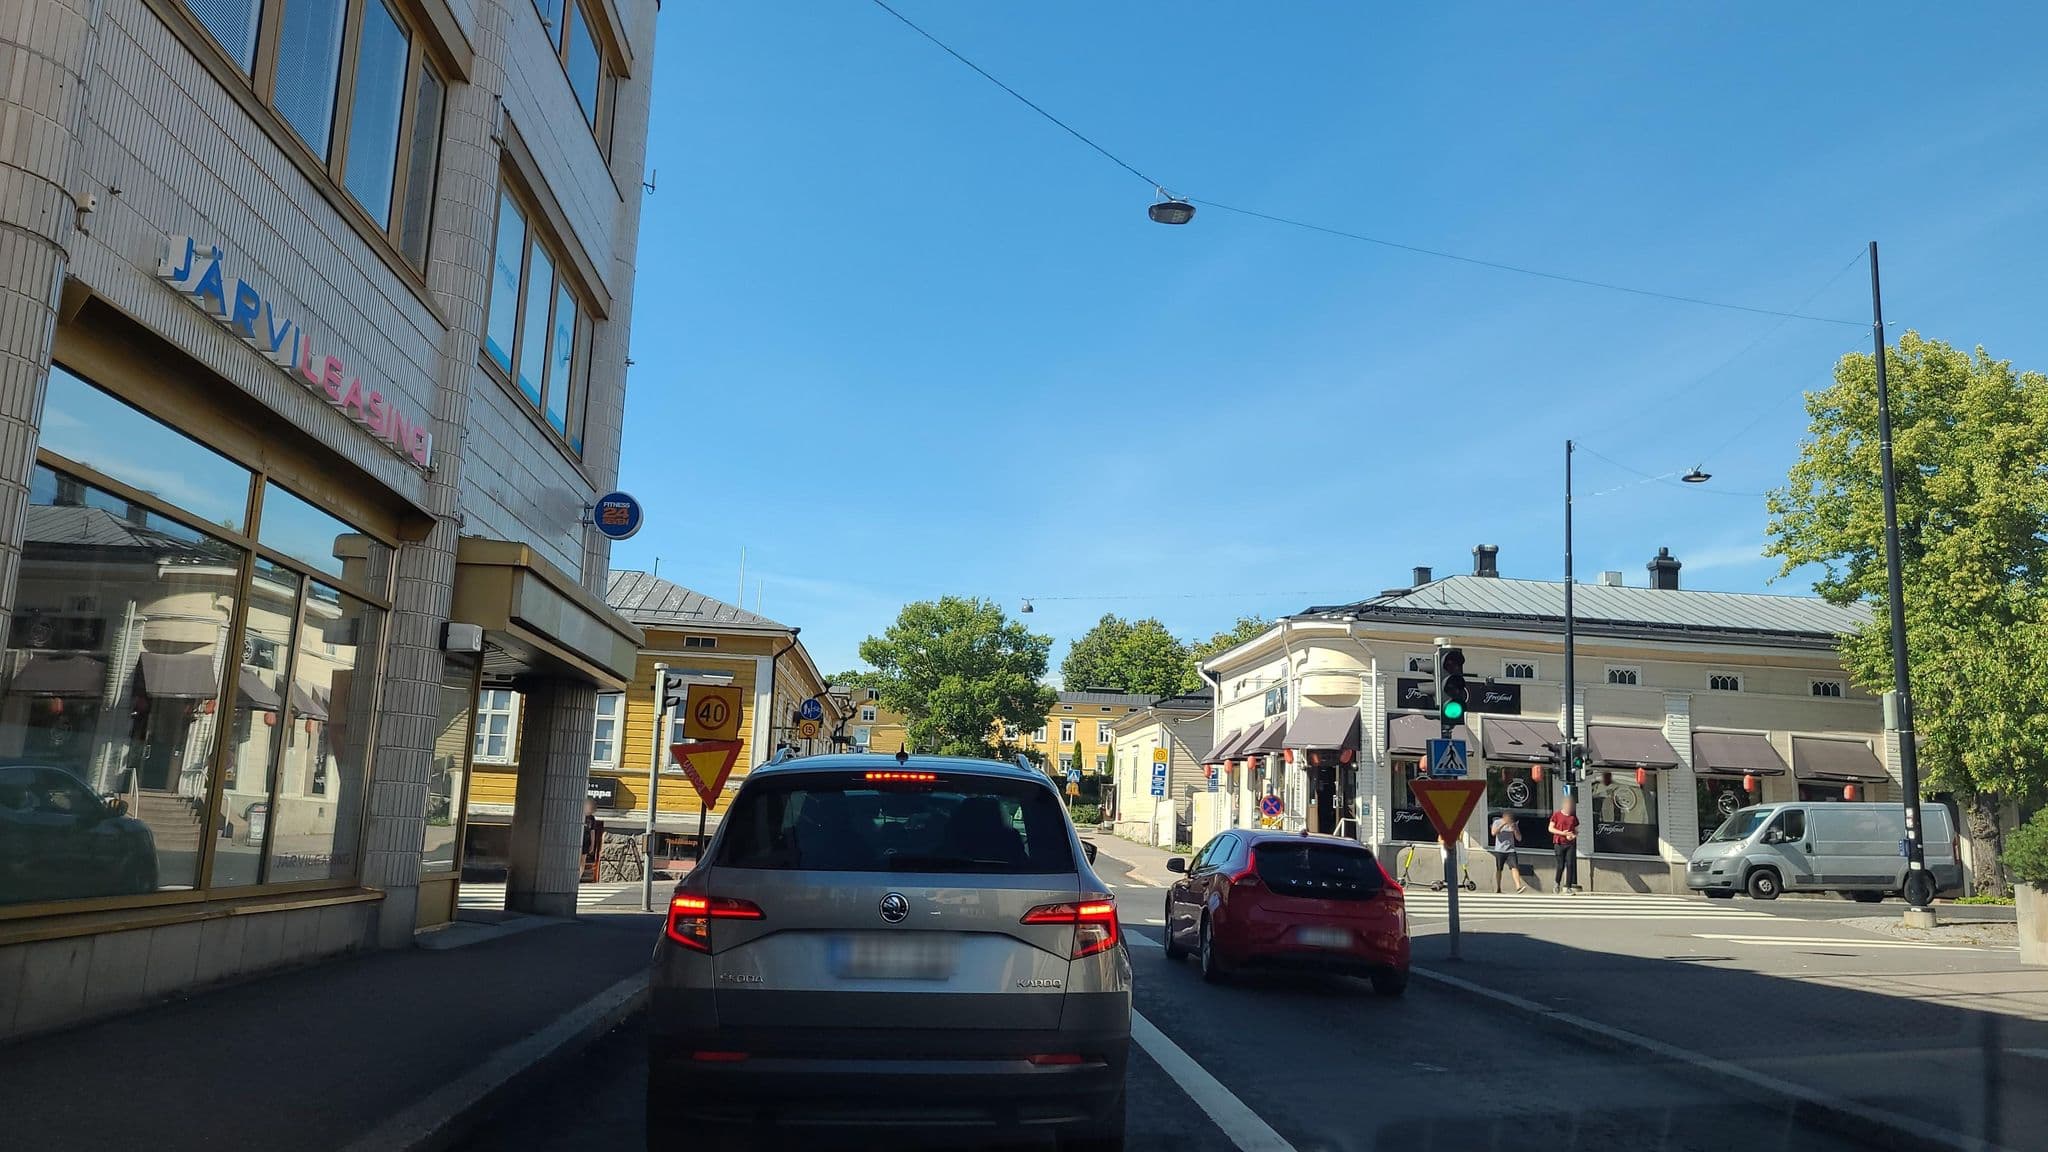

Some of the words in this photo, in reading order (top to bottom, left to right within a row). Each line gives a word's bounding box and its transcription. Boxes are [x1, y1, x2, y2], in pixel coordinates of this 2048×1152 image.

[603, 507, 629, 518] 24
[700, 702, 725, 722] 40
[1154, 763, 1165, 775] P
[1290, 879, 1357, 889] VOLVO
[1016, 978, 1062, 989] KAROQ
